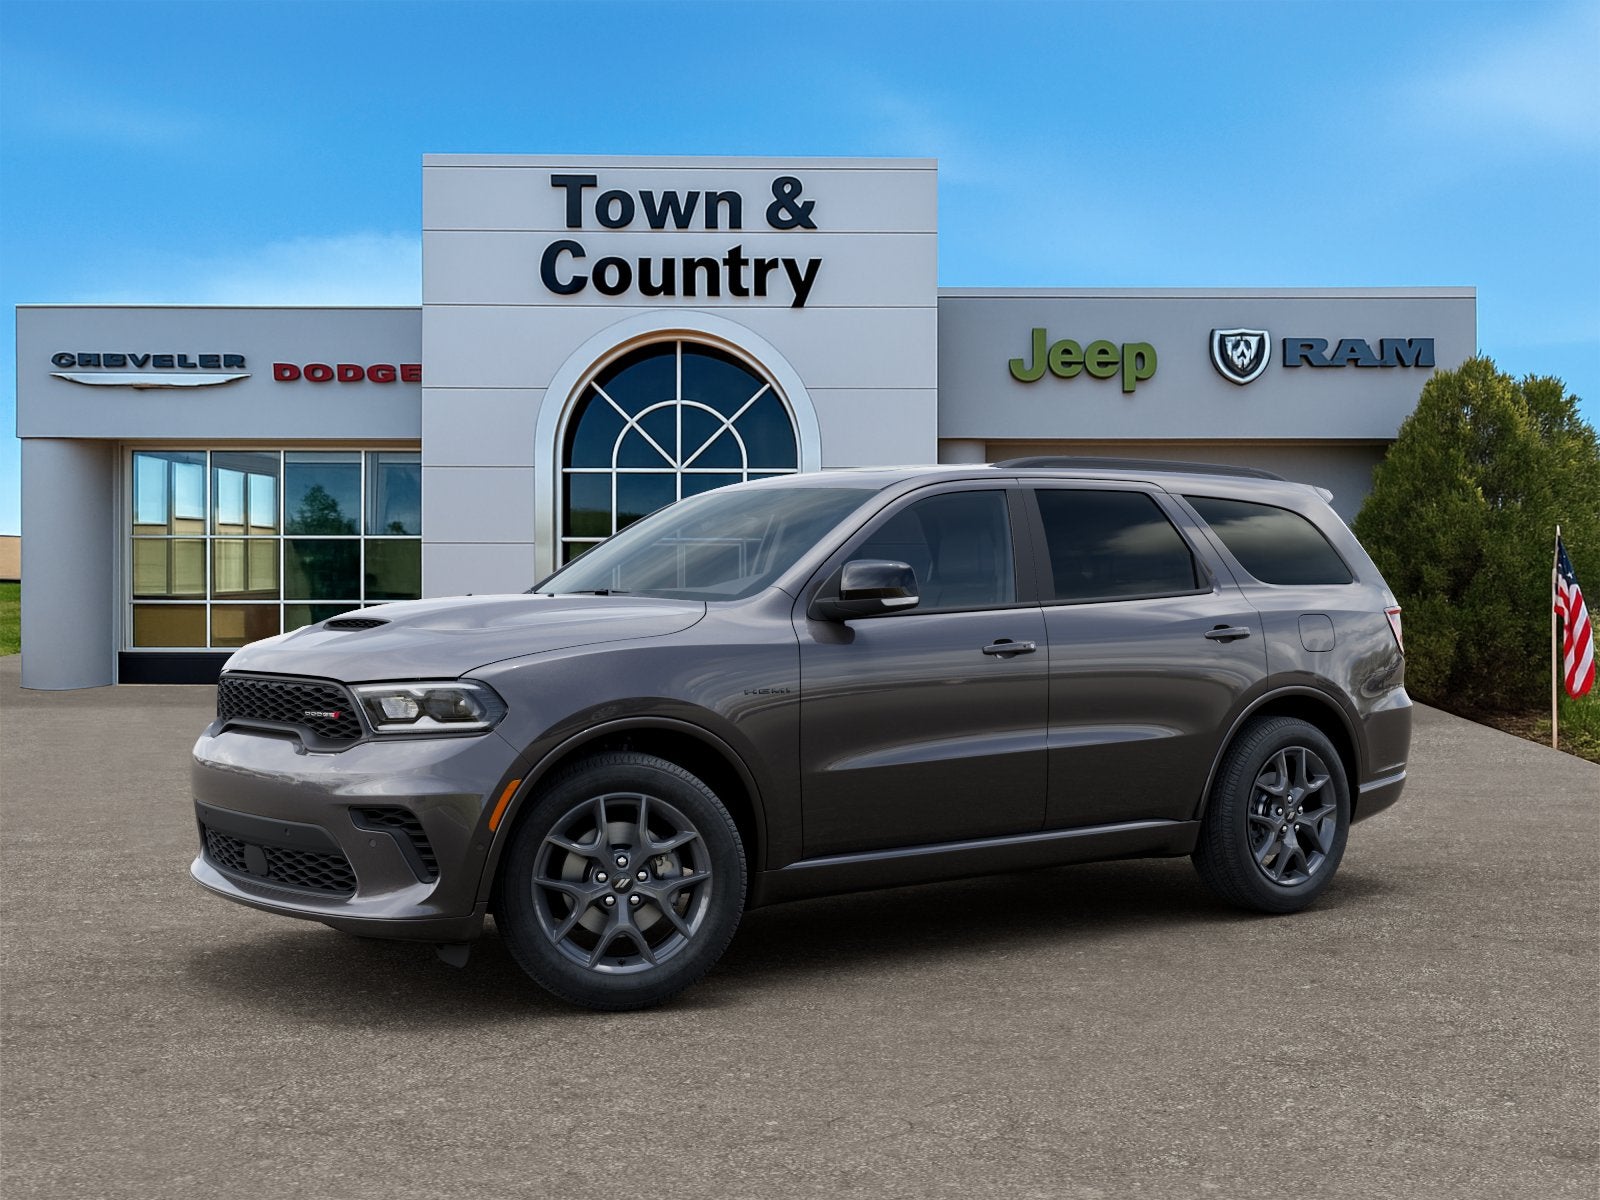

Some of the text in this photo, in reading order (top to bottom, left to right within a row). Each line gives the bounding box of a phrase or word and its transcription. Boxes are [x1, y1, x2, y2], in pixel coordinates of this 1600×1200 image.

[550, 174, 818, 230] Town &
[540, 239, 823, 308] Country
[273, 363, 422, 383] DODGE
[1009, 327, 1158, 393] Jeep
[1282, 337, 1435, 368] RAM
